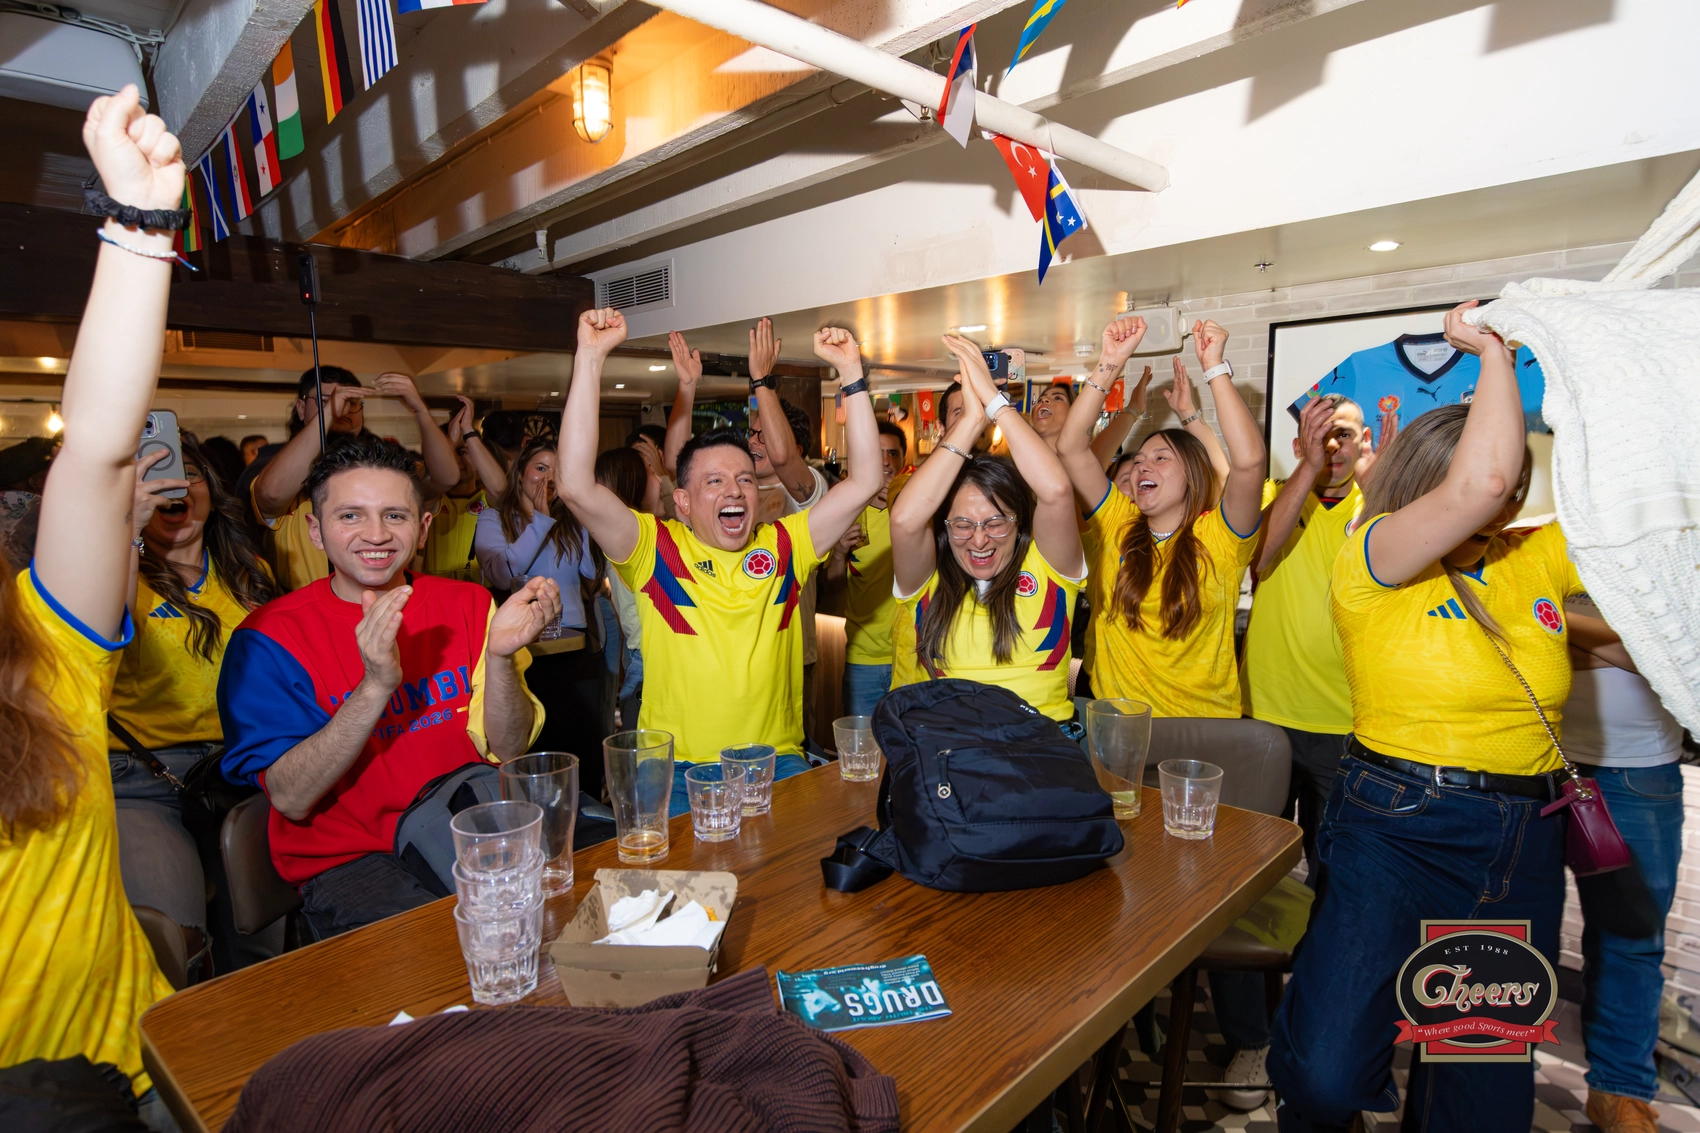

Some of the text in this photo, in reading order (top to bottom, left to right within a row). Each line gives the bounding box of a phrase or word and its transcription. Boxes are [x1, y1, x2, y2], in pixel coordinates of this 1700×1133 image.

[694, 562, 717, 578] adidas
[409, 708, 453, 733] 2026
[843, 980, 945, 1017] DRUGS
